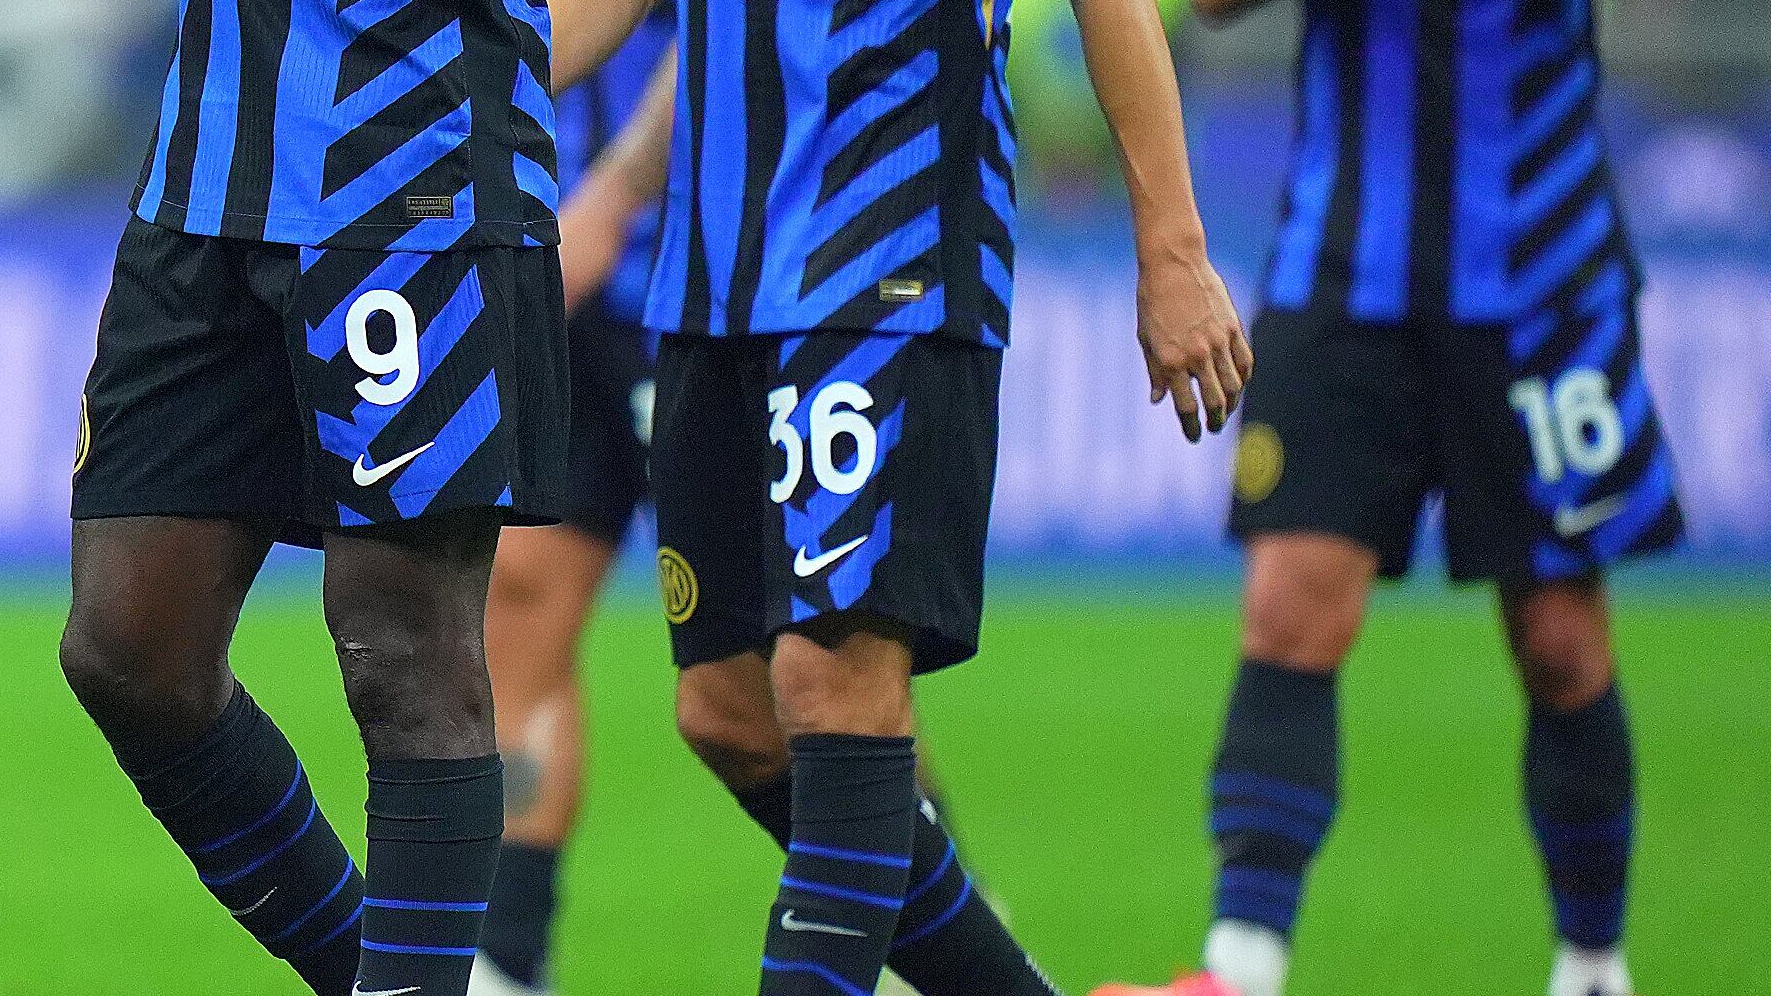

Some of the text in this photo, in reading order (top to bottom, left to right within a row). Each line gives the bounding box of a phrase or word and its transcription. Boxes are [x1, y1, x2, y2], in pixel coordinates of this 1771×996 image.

[344, 289, 419, 406] 9
[768, 381, 878, 504] 36
[1509, 368, 1625, 482] 16
